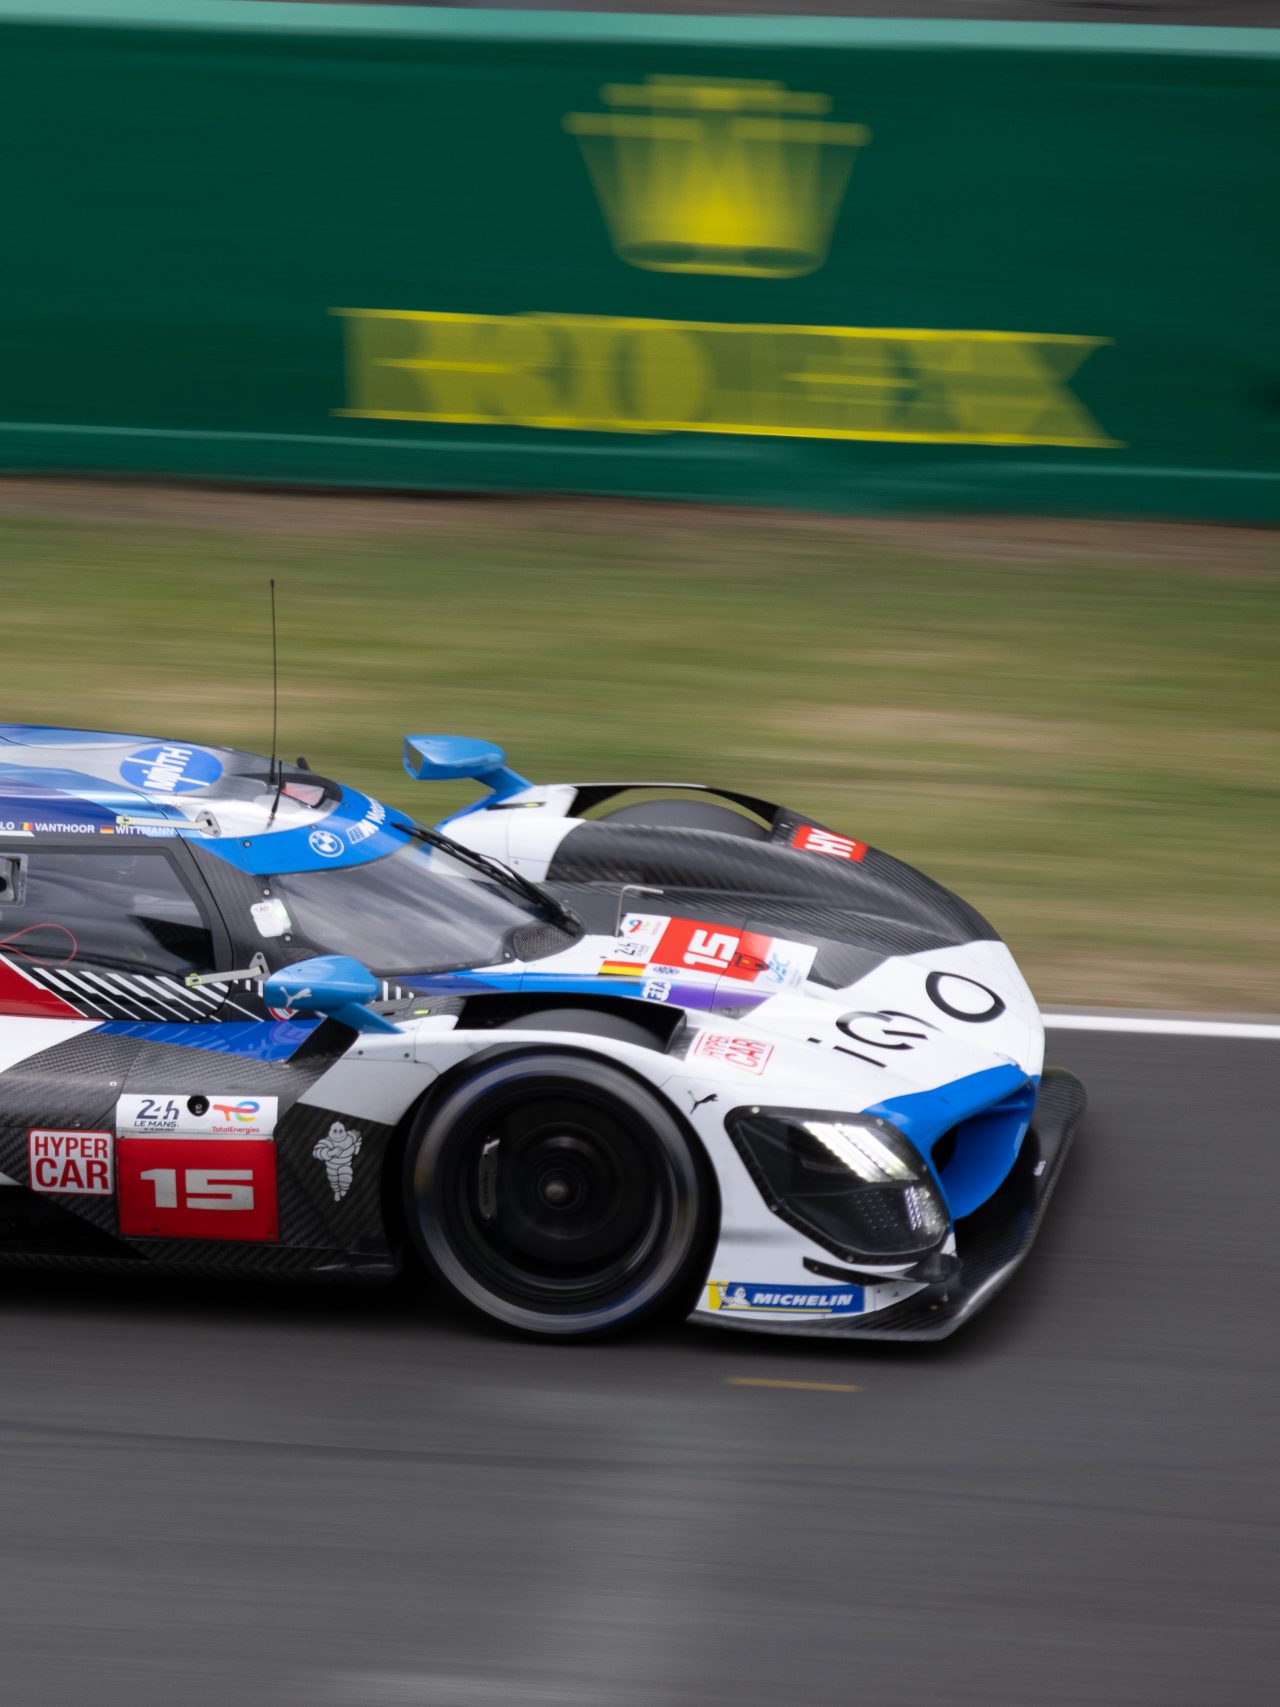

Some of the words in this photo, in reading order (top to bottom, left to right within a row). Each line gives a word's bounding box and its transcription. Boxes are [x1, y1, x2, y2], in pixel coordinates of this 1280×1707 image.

[34, 822, 95, 834] VANTHOOR
[115, 825, 175, 836] WITTMANN
[804, 827, 857, 858] HY
[683, 929, 740, 969] 15
[147, 1120, 177, 1128] MANS
[212, 1126, 261, 1135] TotalEnergies
[34, 1136, 109, 1158] HYPER
[34, 1158, 111, 1190] CAR
[140, 1167, 255, 1211] 15
[752, 1291, 853, 1307] MICHELIN
